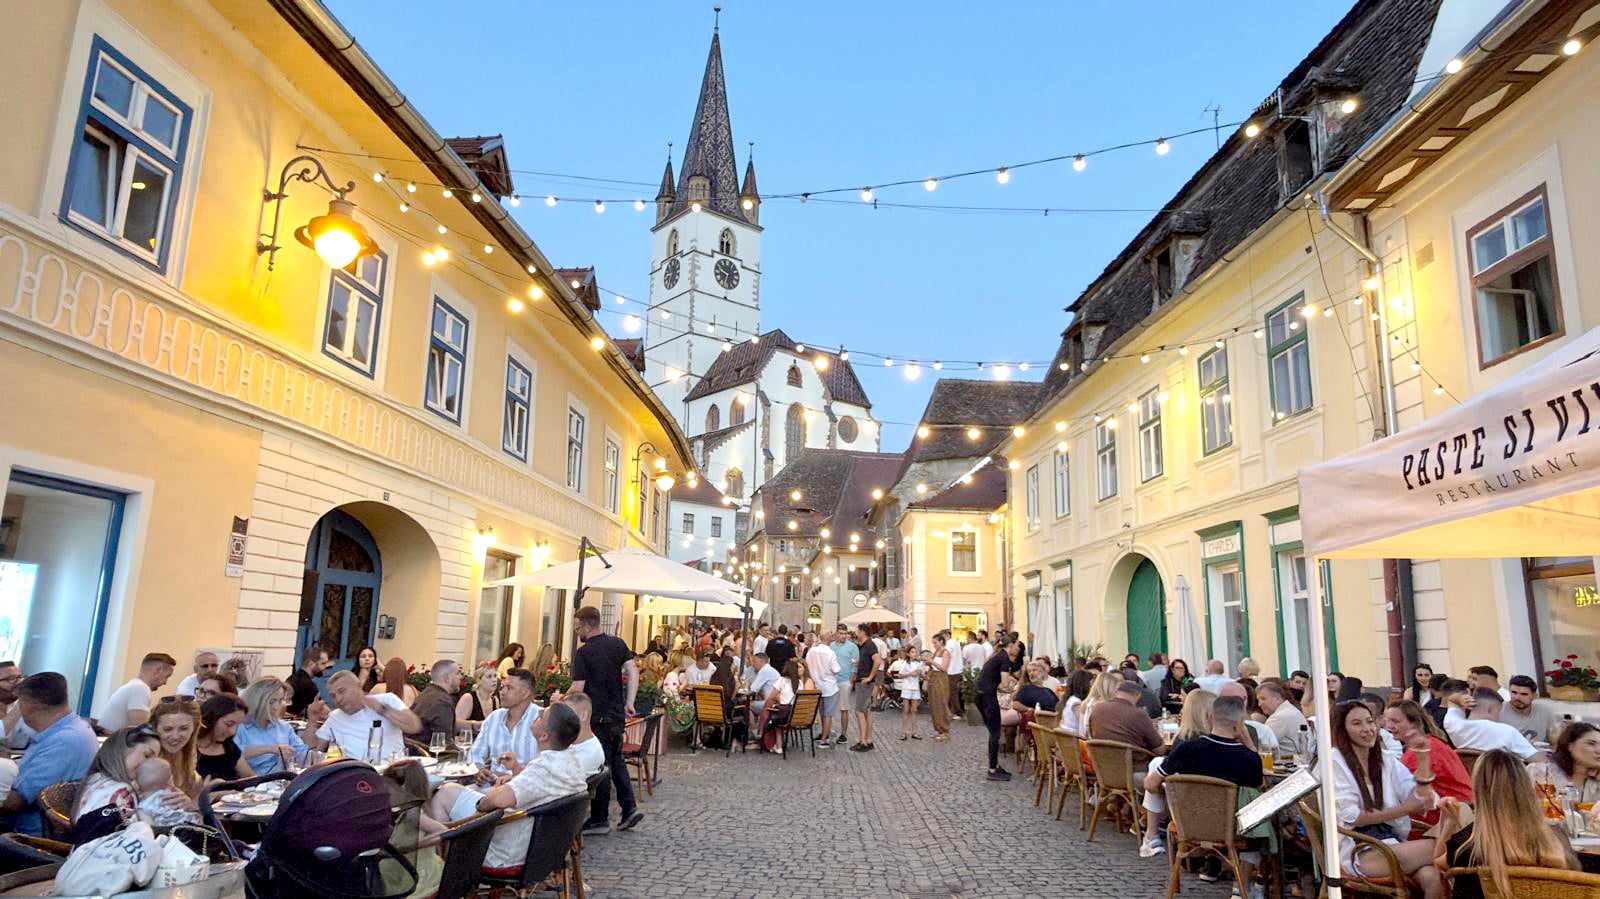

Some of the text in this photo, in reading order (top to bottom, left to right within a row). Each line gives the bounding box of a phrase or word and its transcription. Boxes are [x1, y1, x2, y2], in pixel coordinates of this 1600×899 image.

[1402, 382, 1600, 490] PASTE SI VI
[1437, 451, 1580, 506] RESTAURANT
